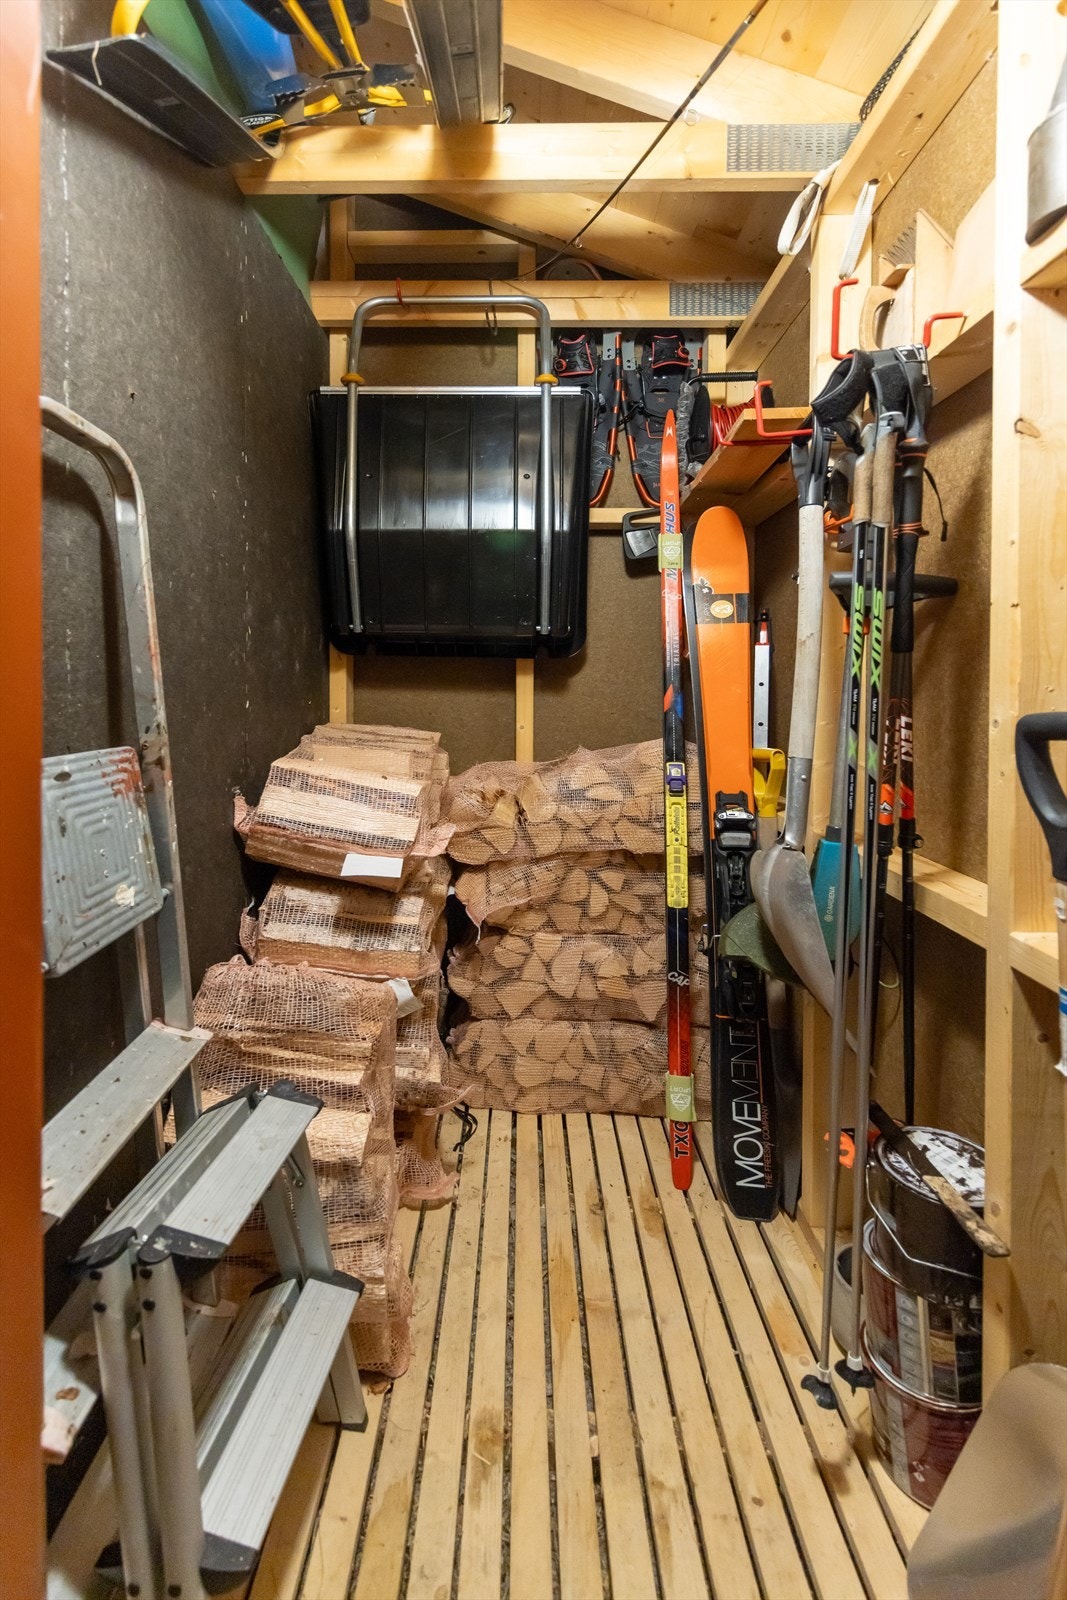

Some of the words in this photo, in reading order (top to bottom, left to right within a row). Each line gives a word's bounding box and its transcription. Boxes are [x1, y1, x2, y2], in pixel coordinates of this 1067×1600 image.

[850, 582, 865, 683] SWIX
[870, 587, 883, 690] SWIX
[900, 715, 914, 762] LEKI
[825, 886, 836, 914] GARDENA
[761, 1104, 770, 1139] COMPANY
[765, 1173, 773, 1189] THE
